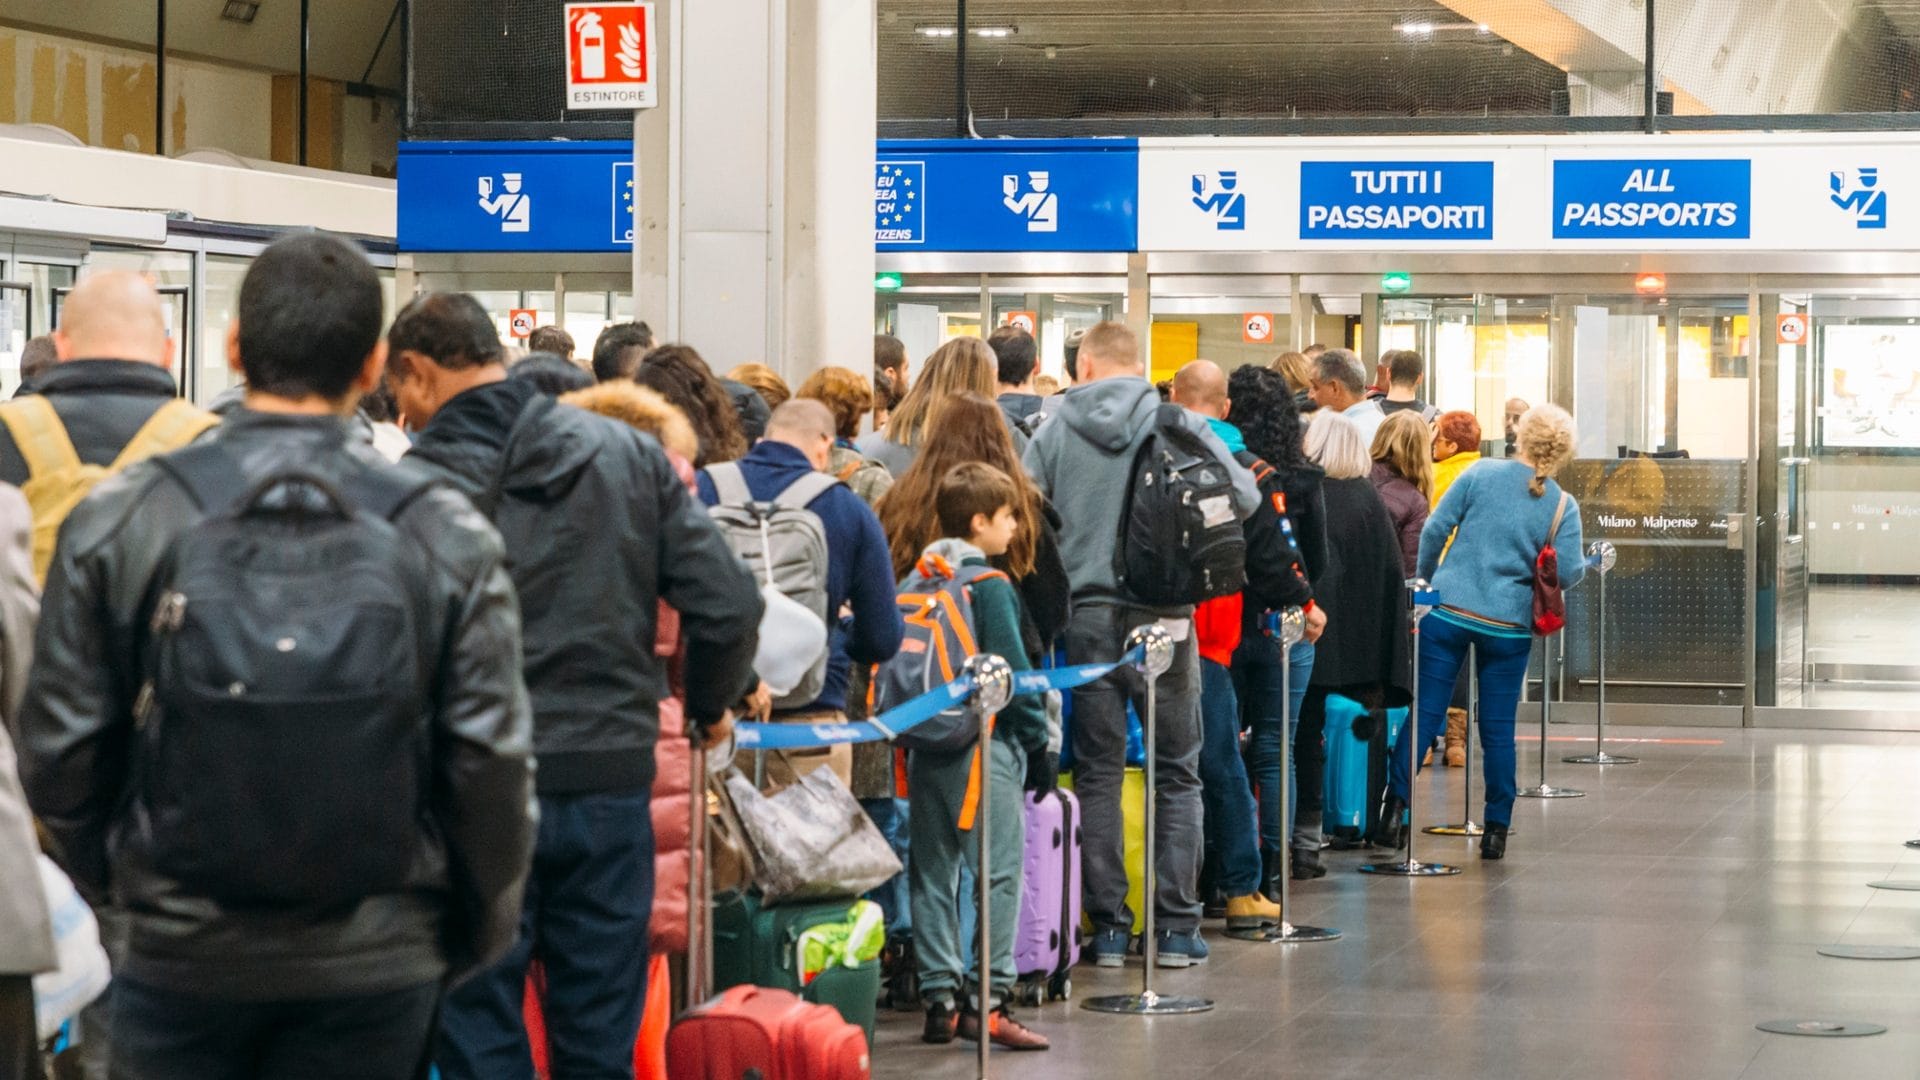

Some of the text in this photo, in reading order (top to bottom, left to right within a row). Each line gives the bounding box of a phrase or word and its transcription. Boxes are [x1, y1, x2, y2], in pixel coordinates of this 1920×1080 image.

[574, 91, 646, 102] ESTINTORE
[877, 176, 895, 187] EU
[1351, 170, 1442, 194] TUTTI I
[1621, 168, 1675, 192] ALL
[875, 189, 897, 200] EEA
[877, 202, 896, 213] CH
[1308, 205, 1485, 229] PASSAPORTI
[1562, 202, 1738, 227] PASSPORTS
[874, 228, 912, 240] TIZENS
[1598, 515, 1637, 528] Milano
[1642, 515, 1698, 530] Malpensa
